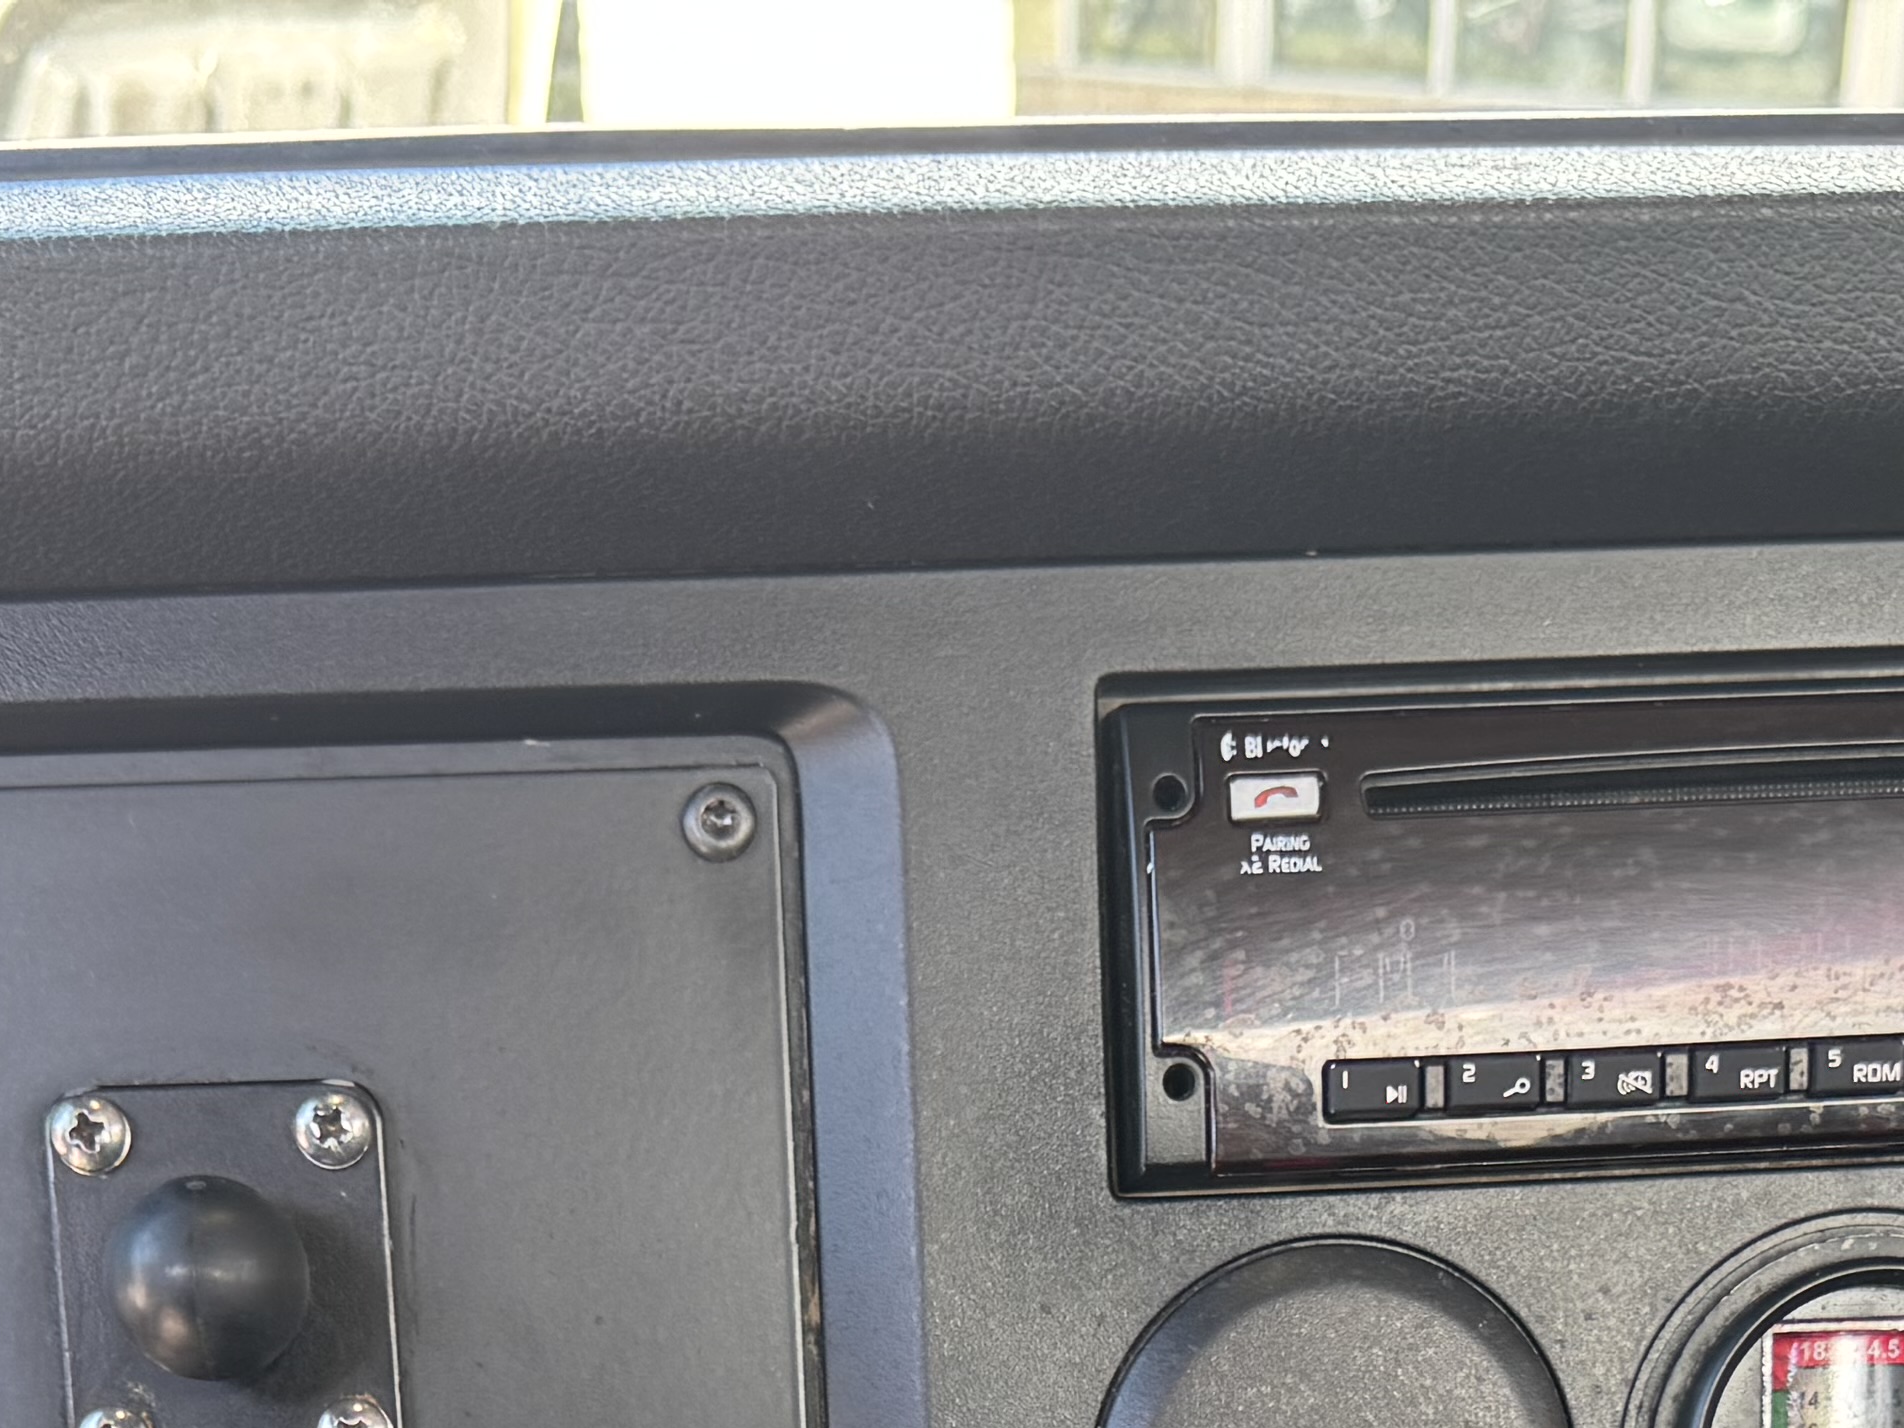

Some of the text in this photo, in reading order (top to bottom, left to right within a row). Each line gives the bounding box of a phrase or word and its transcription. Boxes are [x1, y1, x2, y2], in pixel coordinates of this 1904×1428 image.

[1268, 854, 1322, 873] REDIAL
[1705, 1054, 1719, 1073] 4
[1828, 1049, 1842, 1069] 5
[1462, 1064, 1476, 1083] 2
[1582, 1061, 1596, 1080] 3
[1739, 1068, 1779, 1090] RPT
[1868, 1338, 1901, 1359] 4.5
